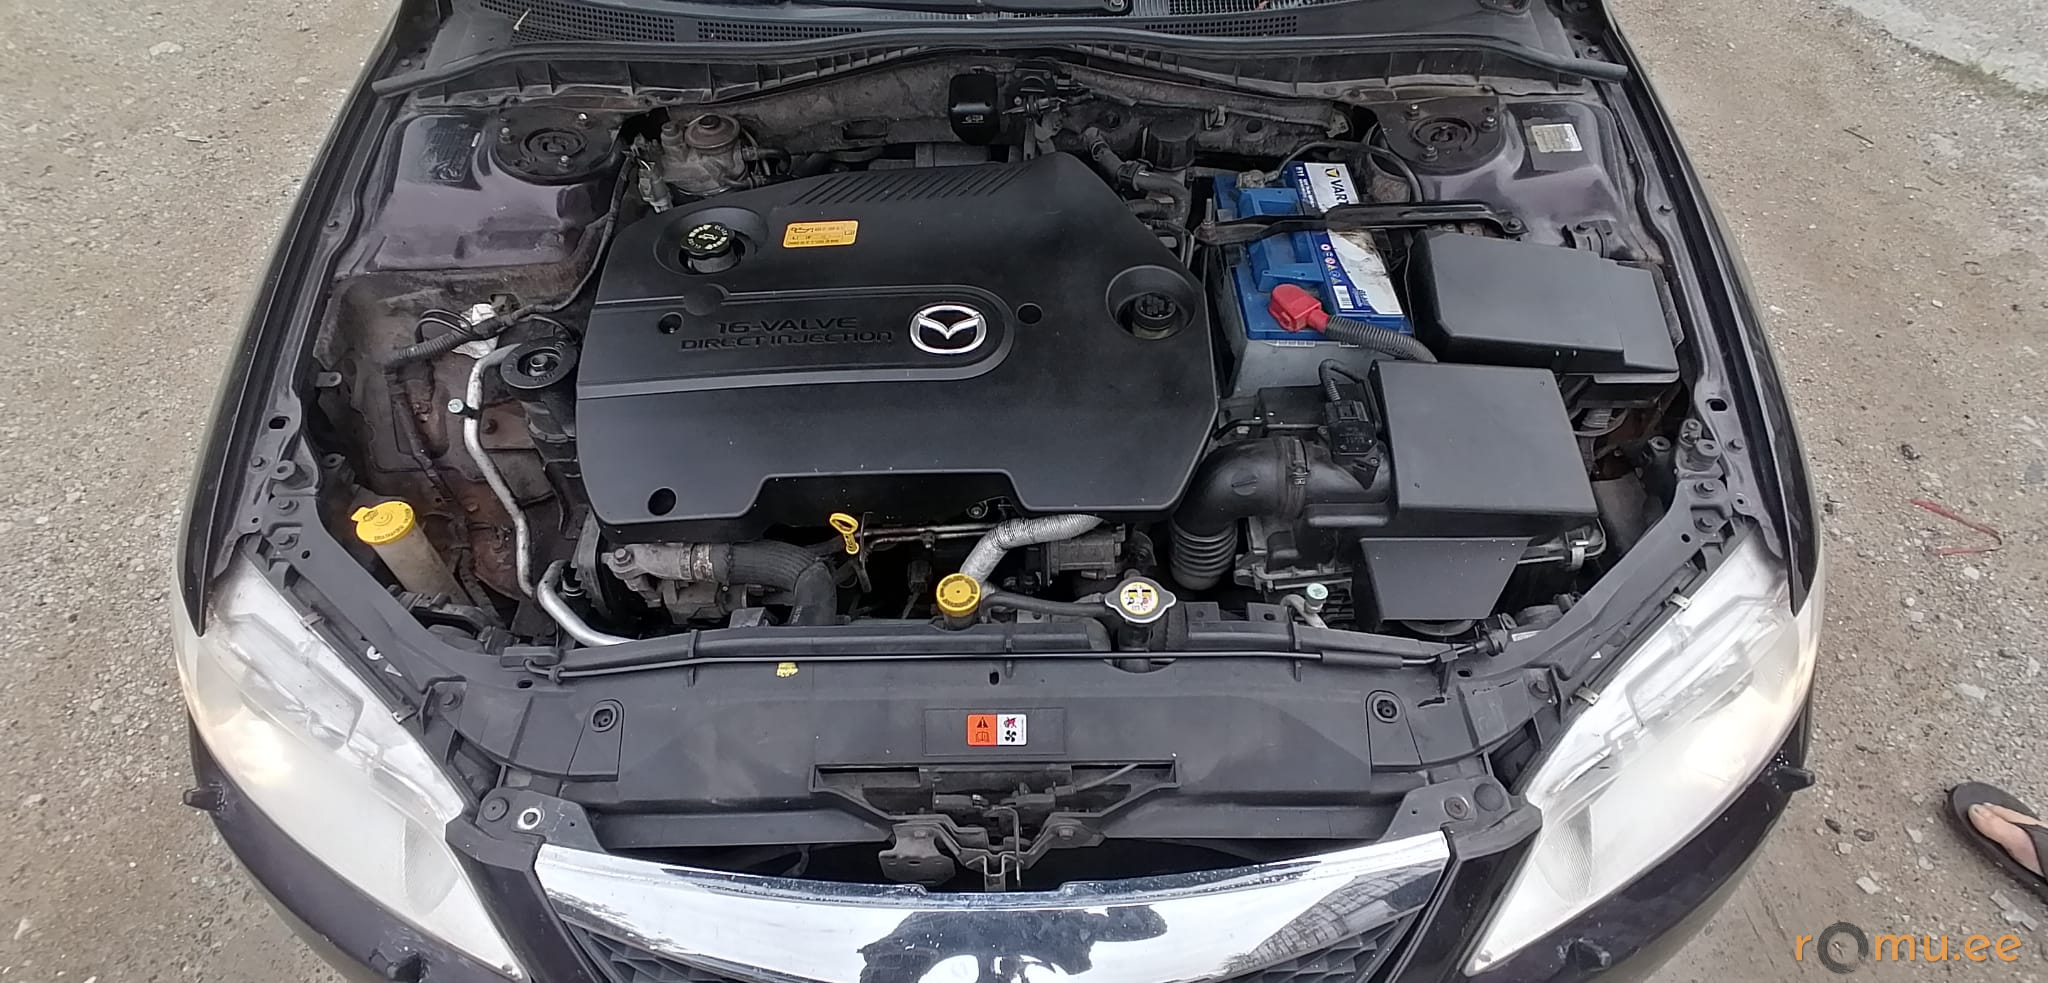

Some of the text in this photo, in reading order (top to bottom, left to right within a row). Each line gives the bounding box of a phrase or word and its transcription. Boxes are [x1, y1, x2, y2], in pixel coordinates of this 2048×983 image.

[717, 316, 858, 335] 16-VALVE
[680, 331, 893, 350] DIRECT INJECTION
